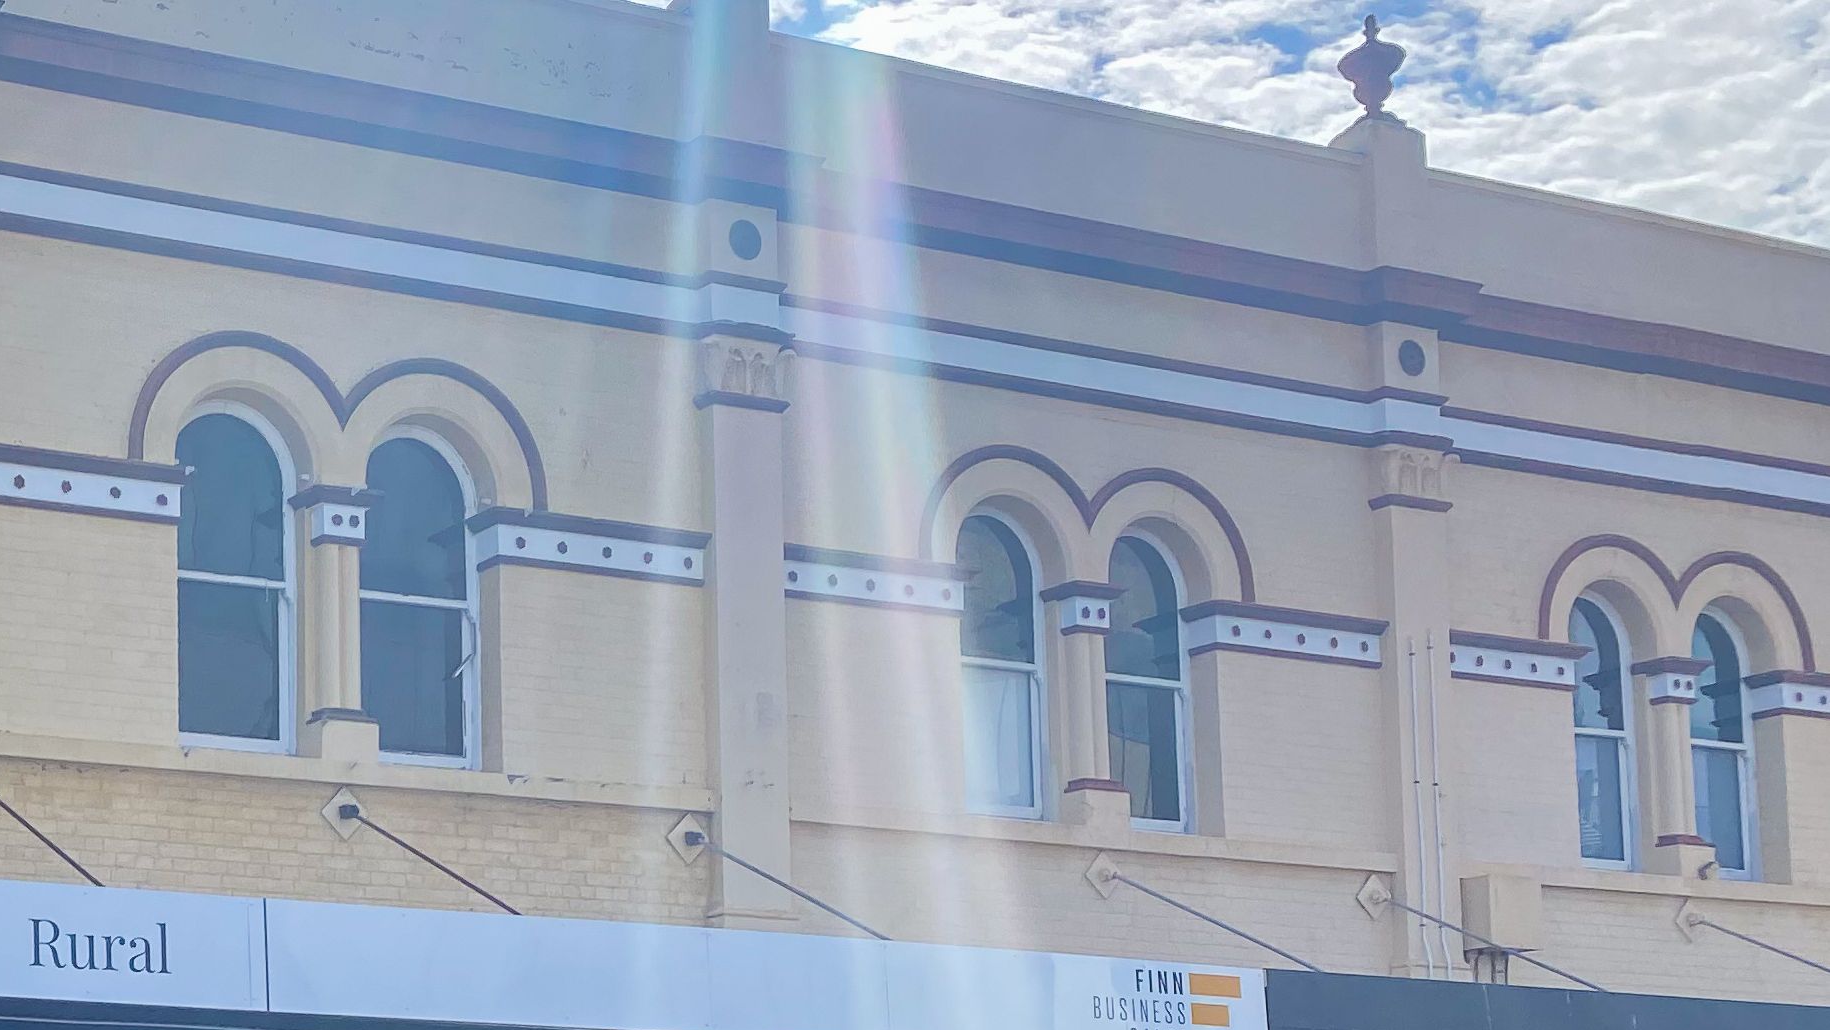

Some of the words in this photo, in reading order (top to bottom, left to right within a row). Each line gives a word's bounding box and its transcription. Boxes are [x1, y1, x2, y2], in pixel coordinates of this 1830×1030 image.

[28, 917, 173, 975] Rural
[1135, 969, 1184, 995] FINN
[1093, 995, 1187, 1025] BUSINESS
